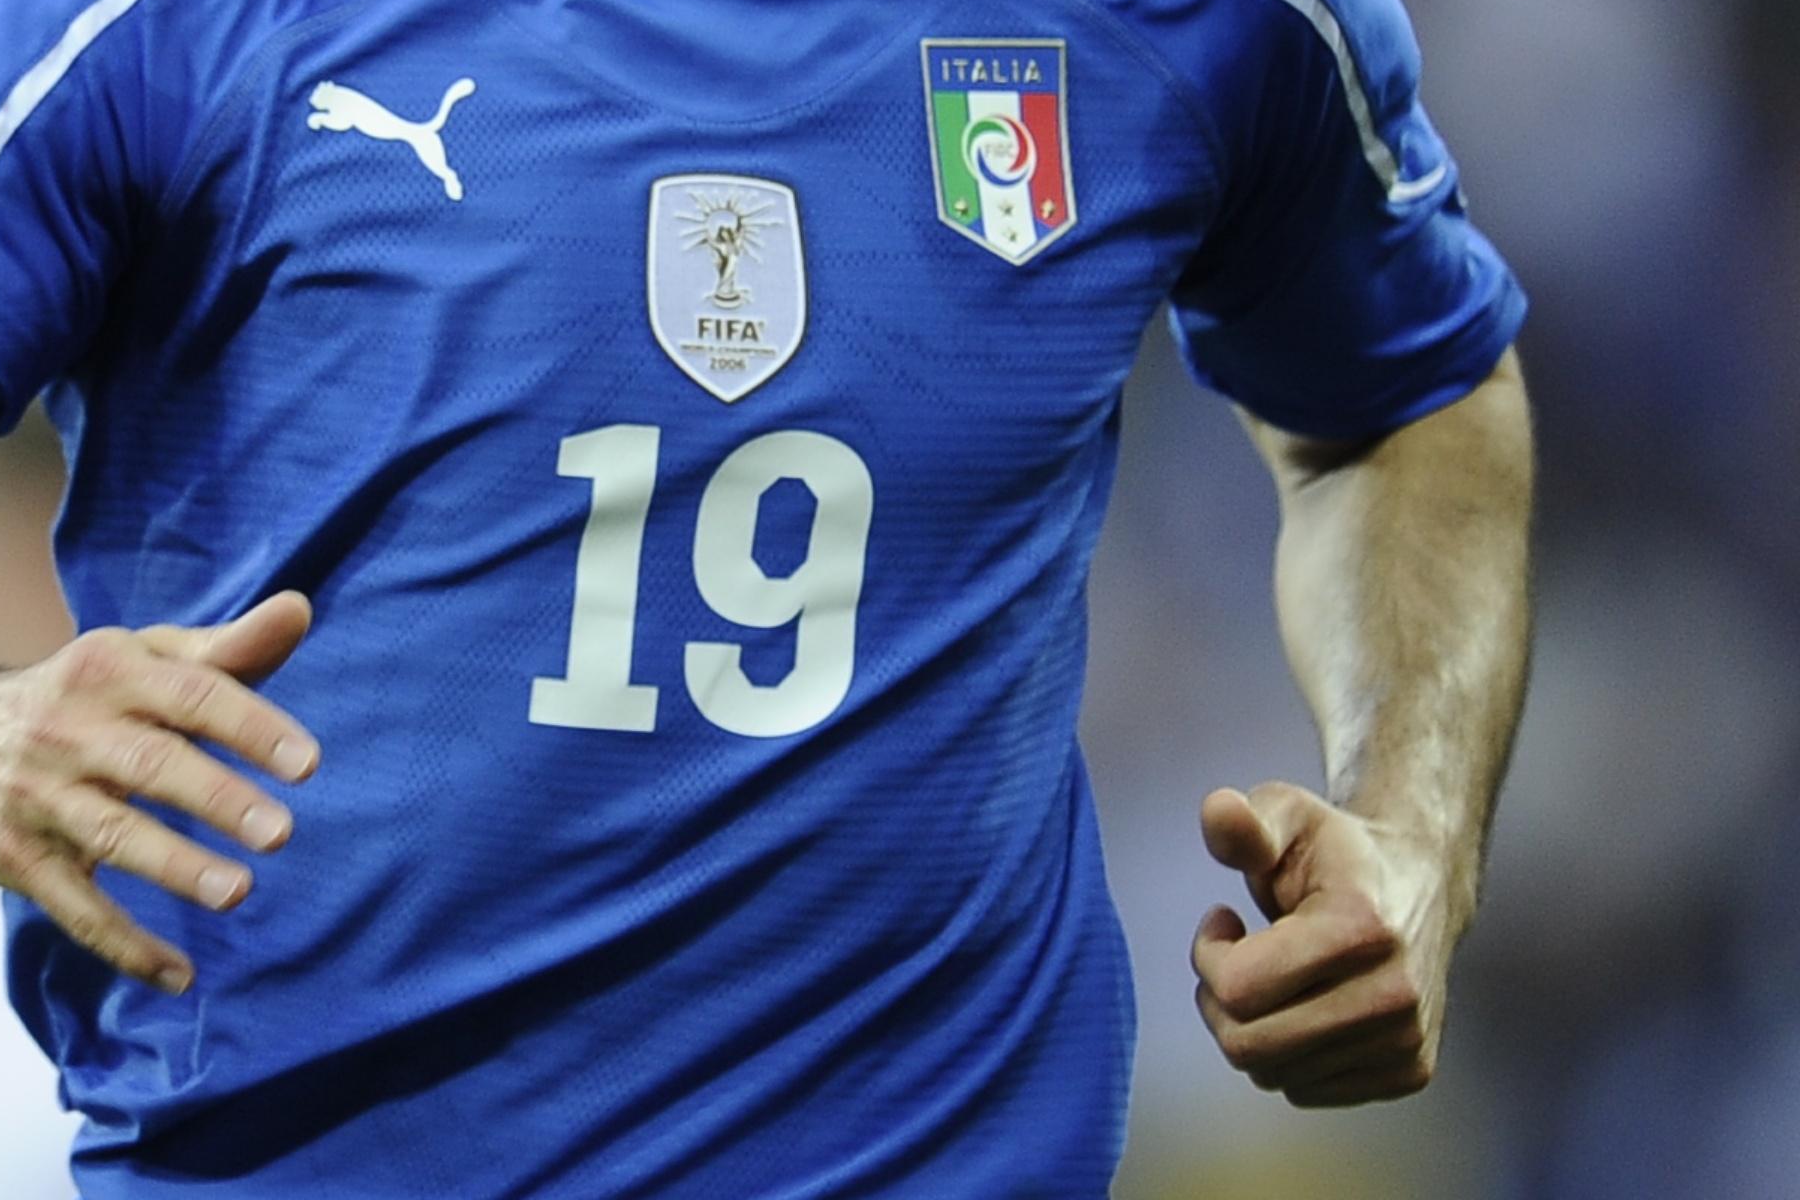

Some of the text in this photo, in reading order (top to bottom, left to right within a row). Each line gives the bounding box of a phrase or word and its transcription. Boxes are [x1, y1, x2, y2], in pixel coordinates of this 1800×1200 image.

[942, 58, 1042, 83] ITALIA
[698, 318, 759, 342] FIFA
[528, 423, 874, 738] 19
